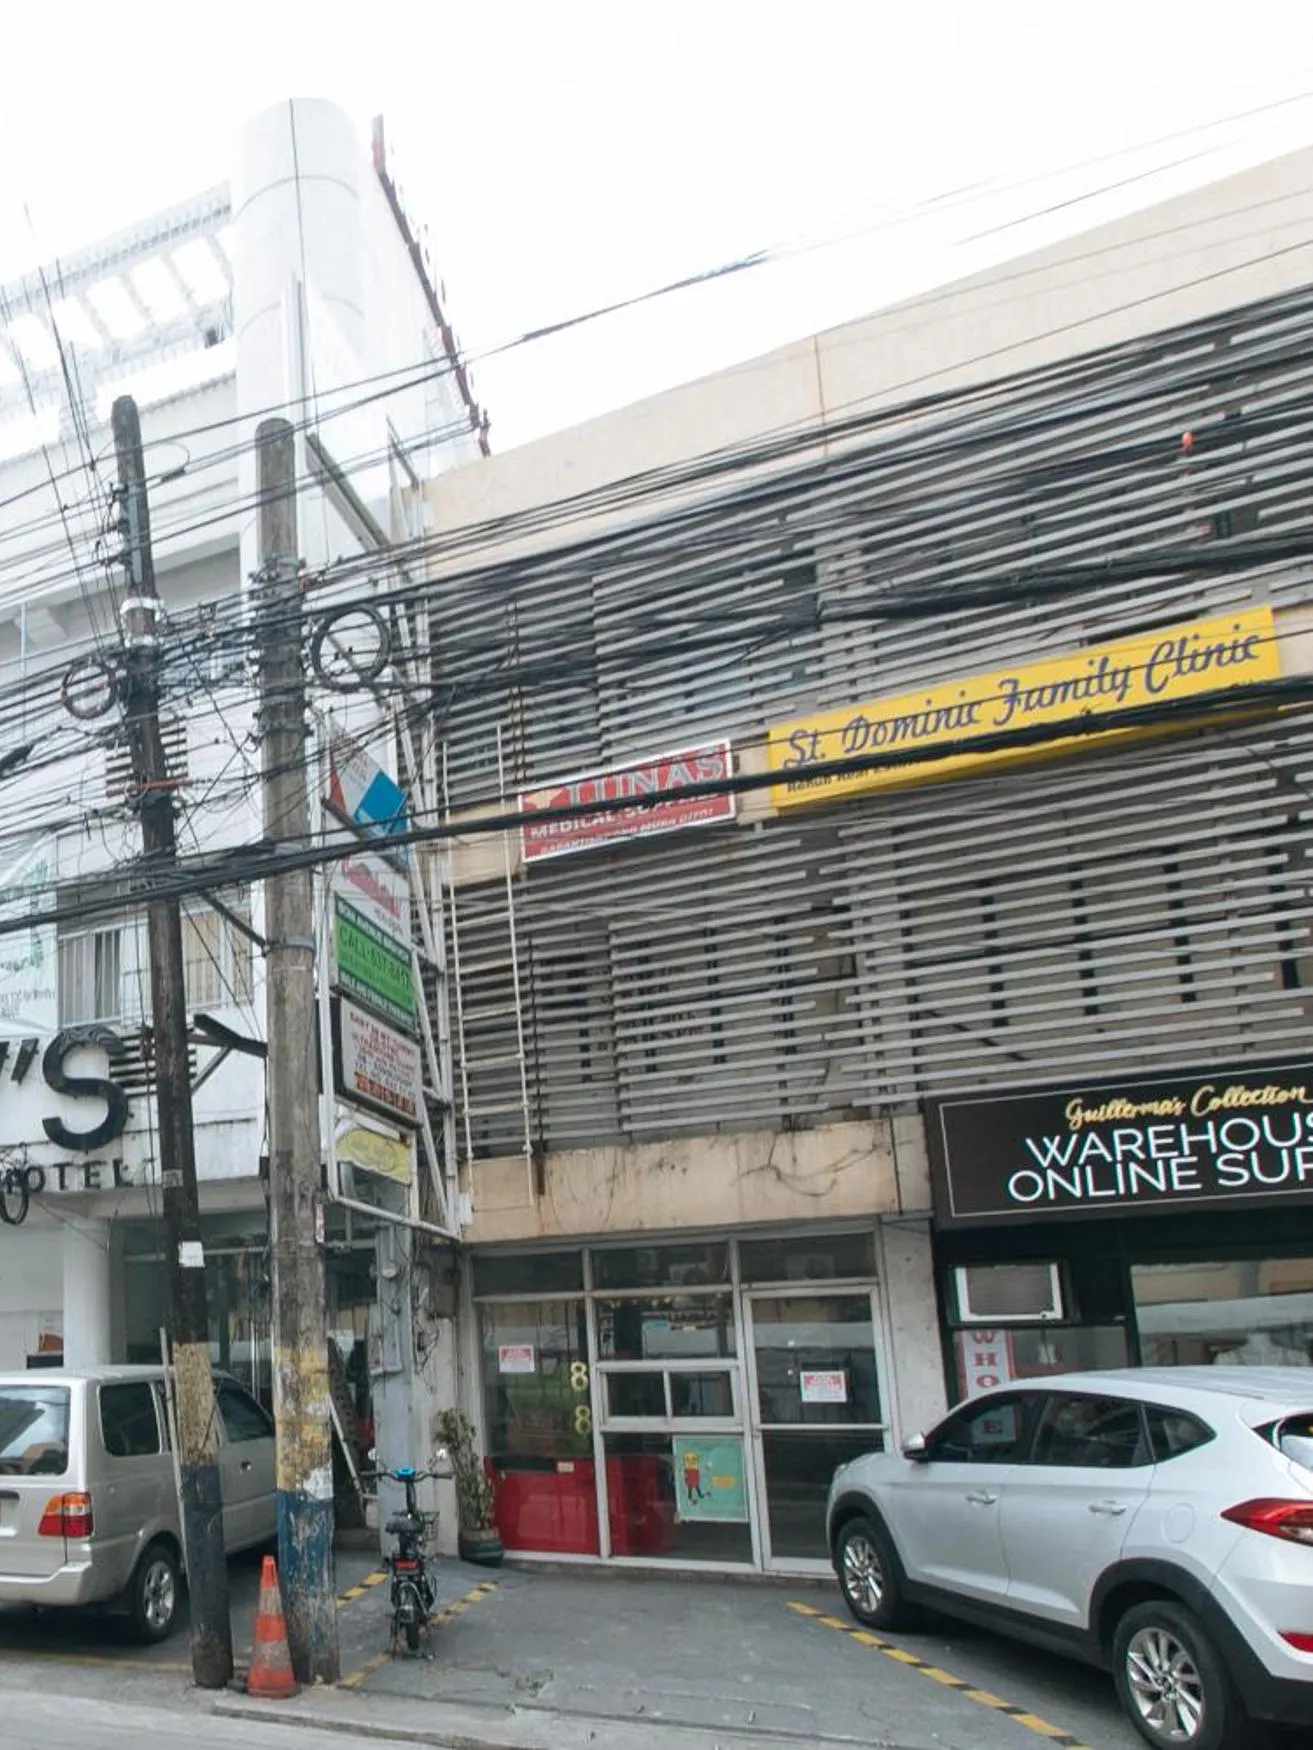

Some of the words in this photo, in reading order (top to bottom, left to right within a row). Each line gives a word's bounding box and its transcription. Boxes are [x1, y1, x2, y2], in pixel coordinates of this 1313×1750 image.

[783, 728, 826, 769] St.
[841, 690, 982, 753] Dominic
[993, 656, 1131, 726] Family
[1144, 624, 1261, 694] Clinic
[1190, 1084, 1308, 1117] Collection
[1025, 1111, 1313, 1169] WAREHOU
[1008, 1156, 1202, 1202] ONLINE
